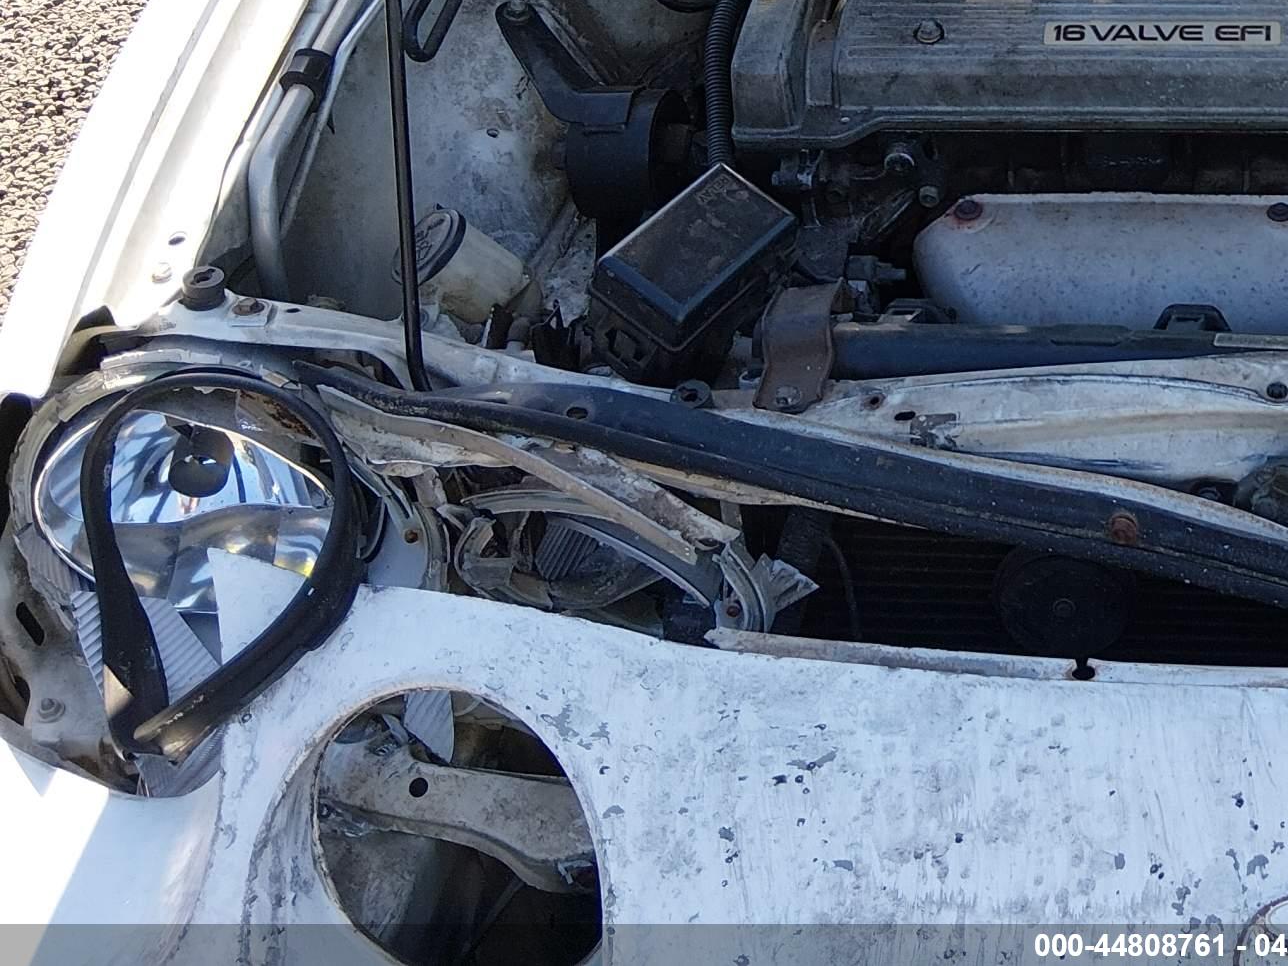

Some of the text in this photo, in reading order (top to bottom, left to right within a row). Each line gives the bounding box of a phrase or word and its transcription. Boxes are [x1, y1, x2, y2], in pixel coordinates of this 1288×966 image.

[1053, 24, 1272, 42] 16 VALVE EFI
